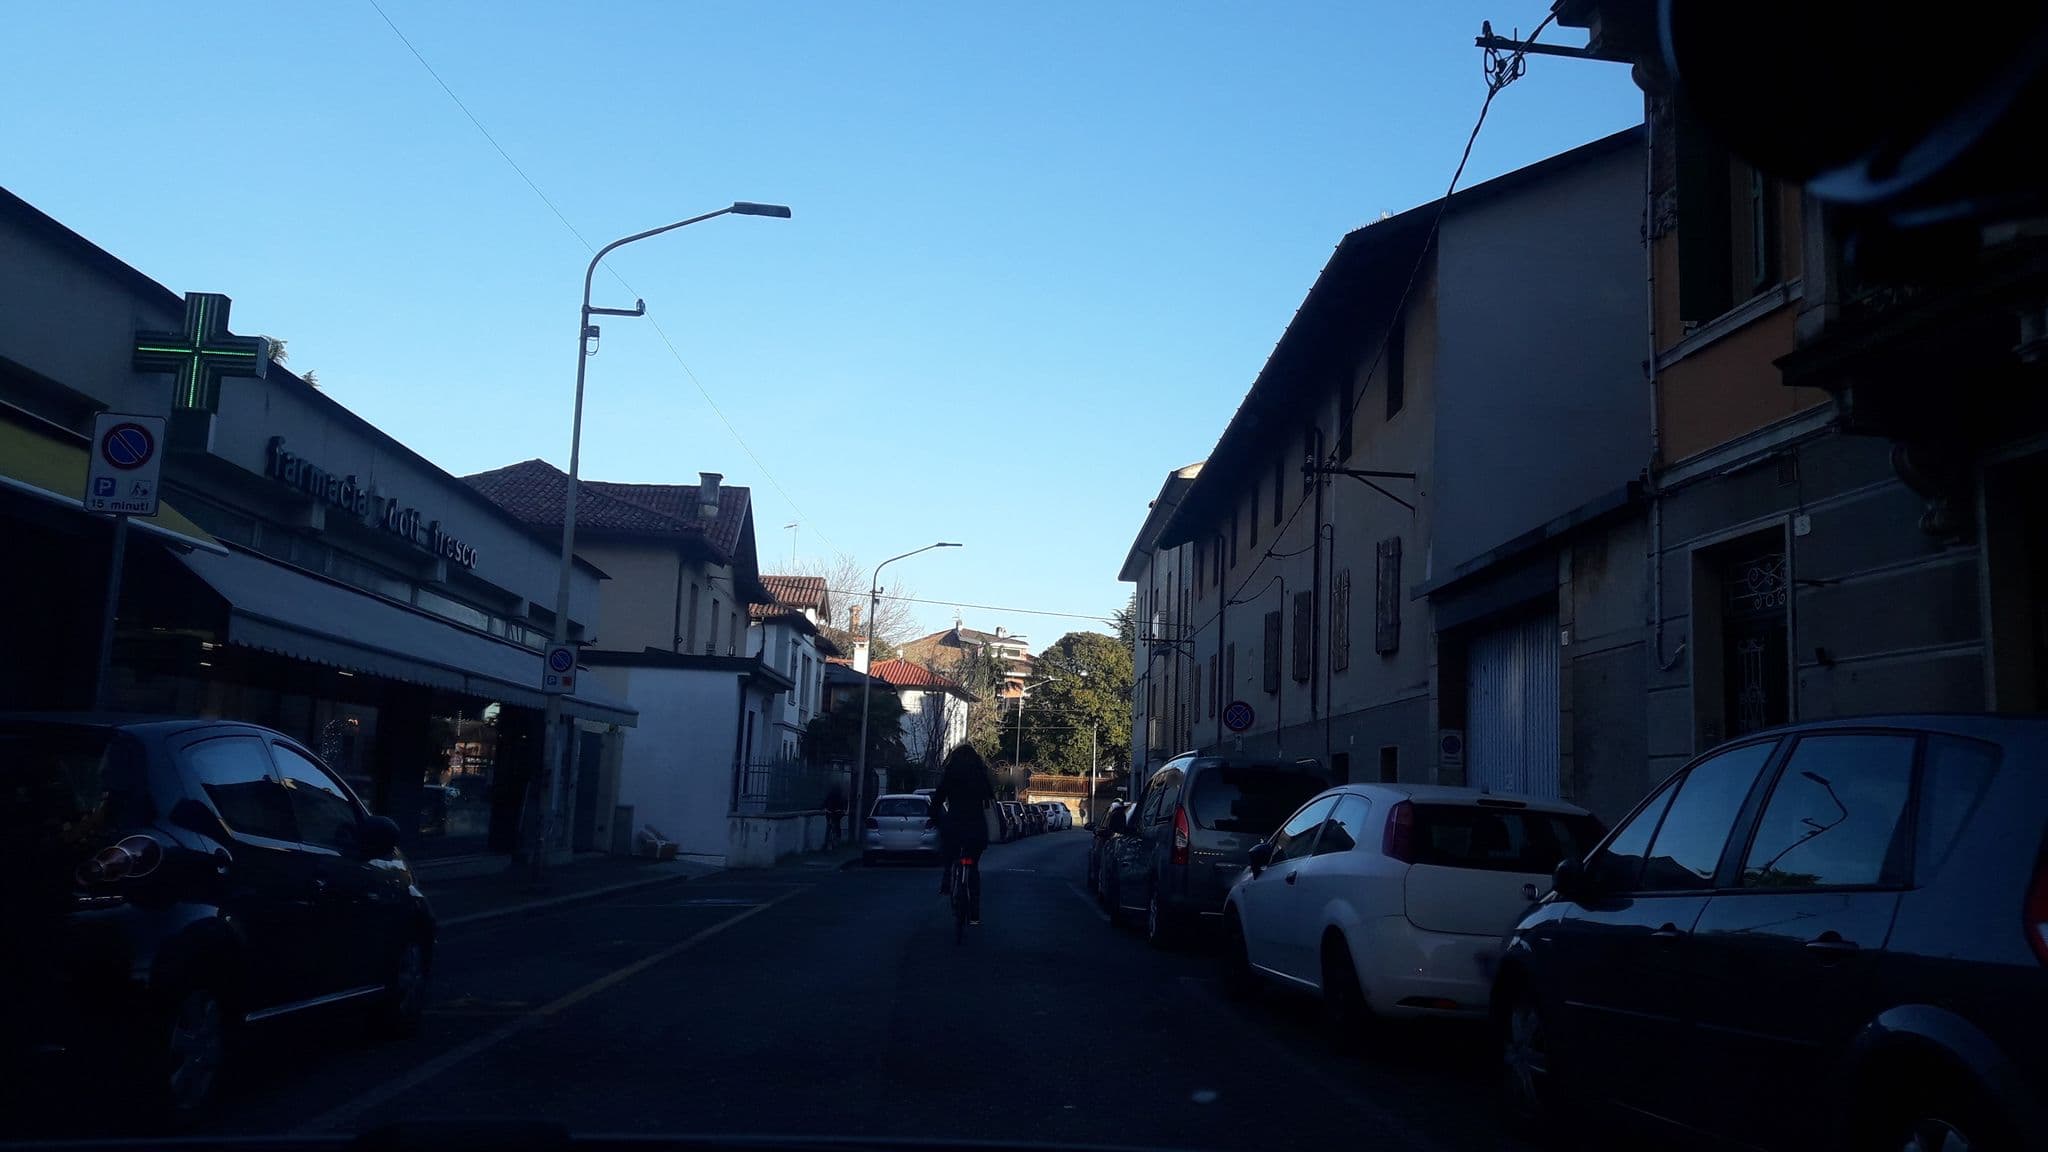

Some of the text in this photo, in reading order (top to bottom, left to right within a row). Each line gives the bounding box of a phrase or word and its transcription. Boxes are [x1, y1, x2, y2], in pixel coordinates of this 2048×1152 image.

[265, 436, 369, 516] farmacia
[91, 498, 150, 511] 15 minuti
